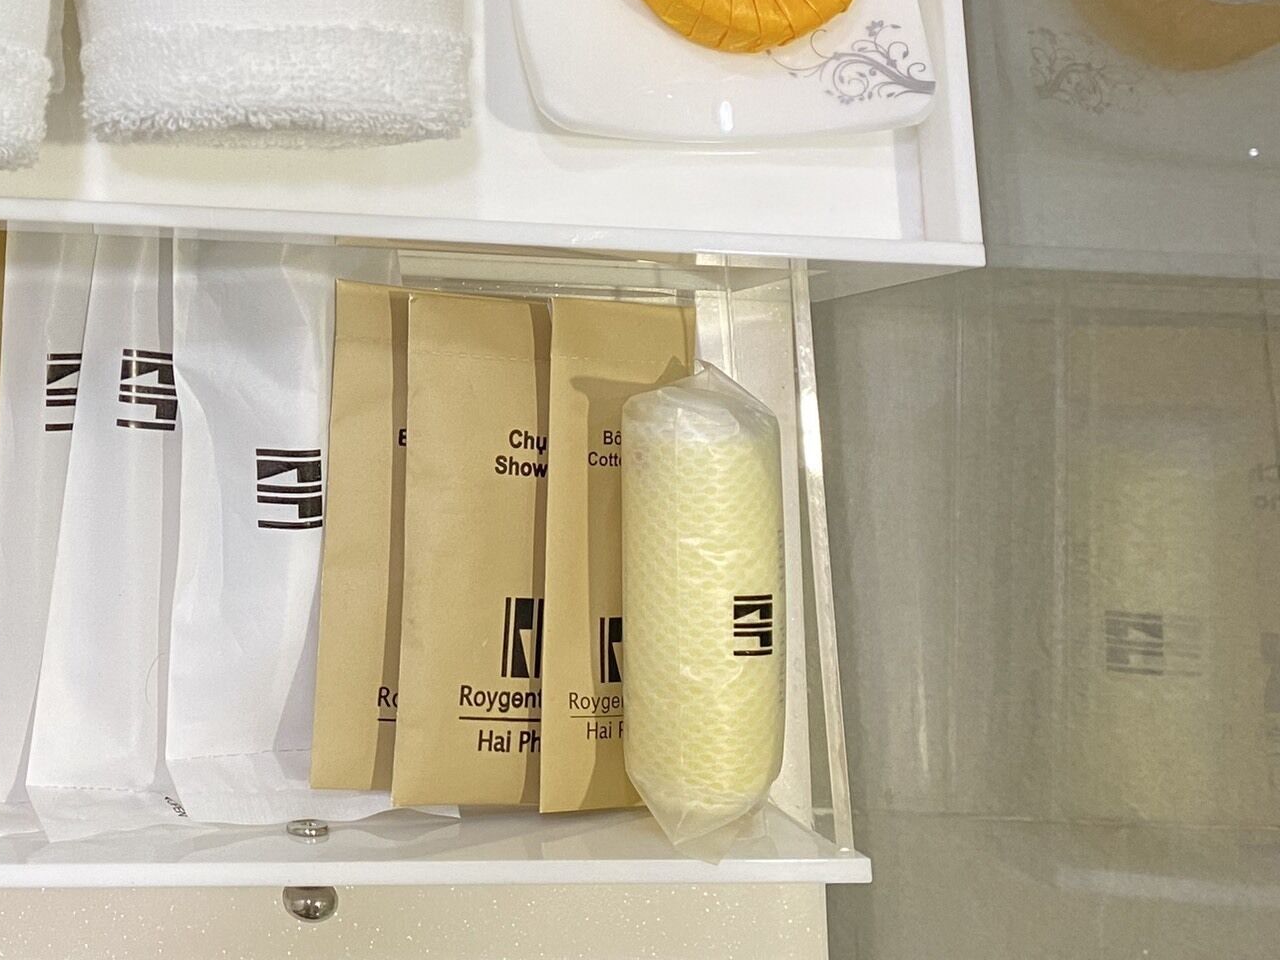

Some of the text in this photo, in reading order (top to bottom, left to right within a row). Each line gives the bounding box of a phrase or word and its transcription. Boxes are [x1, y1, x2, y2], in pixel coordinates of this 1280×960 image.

[509, 429, 547, 454] Chụ
[603, 430, 622, 445] Bô
[495, 455, 548, 478] Show
[477, 729, 541, 753] Hai Ph
[587, 721, 612, 740] Hai
